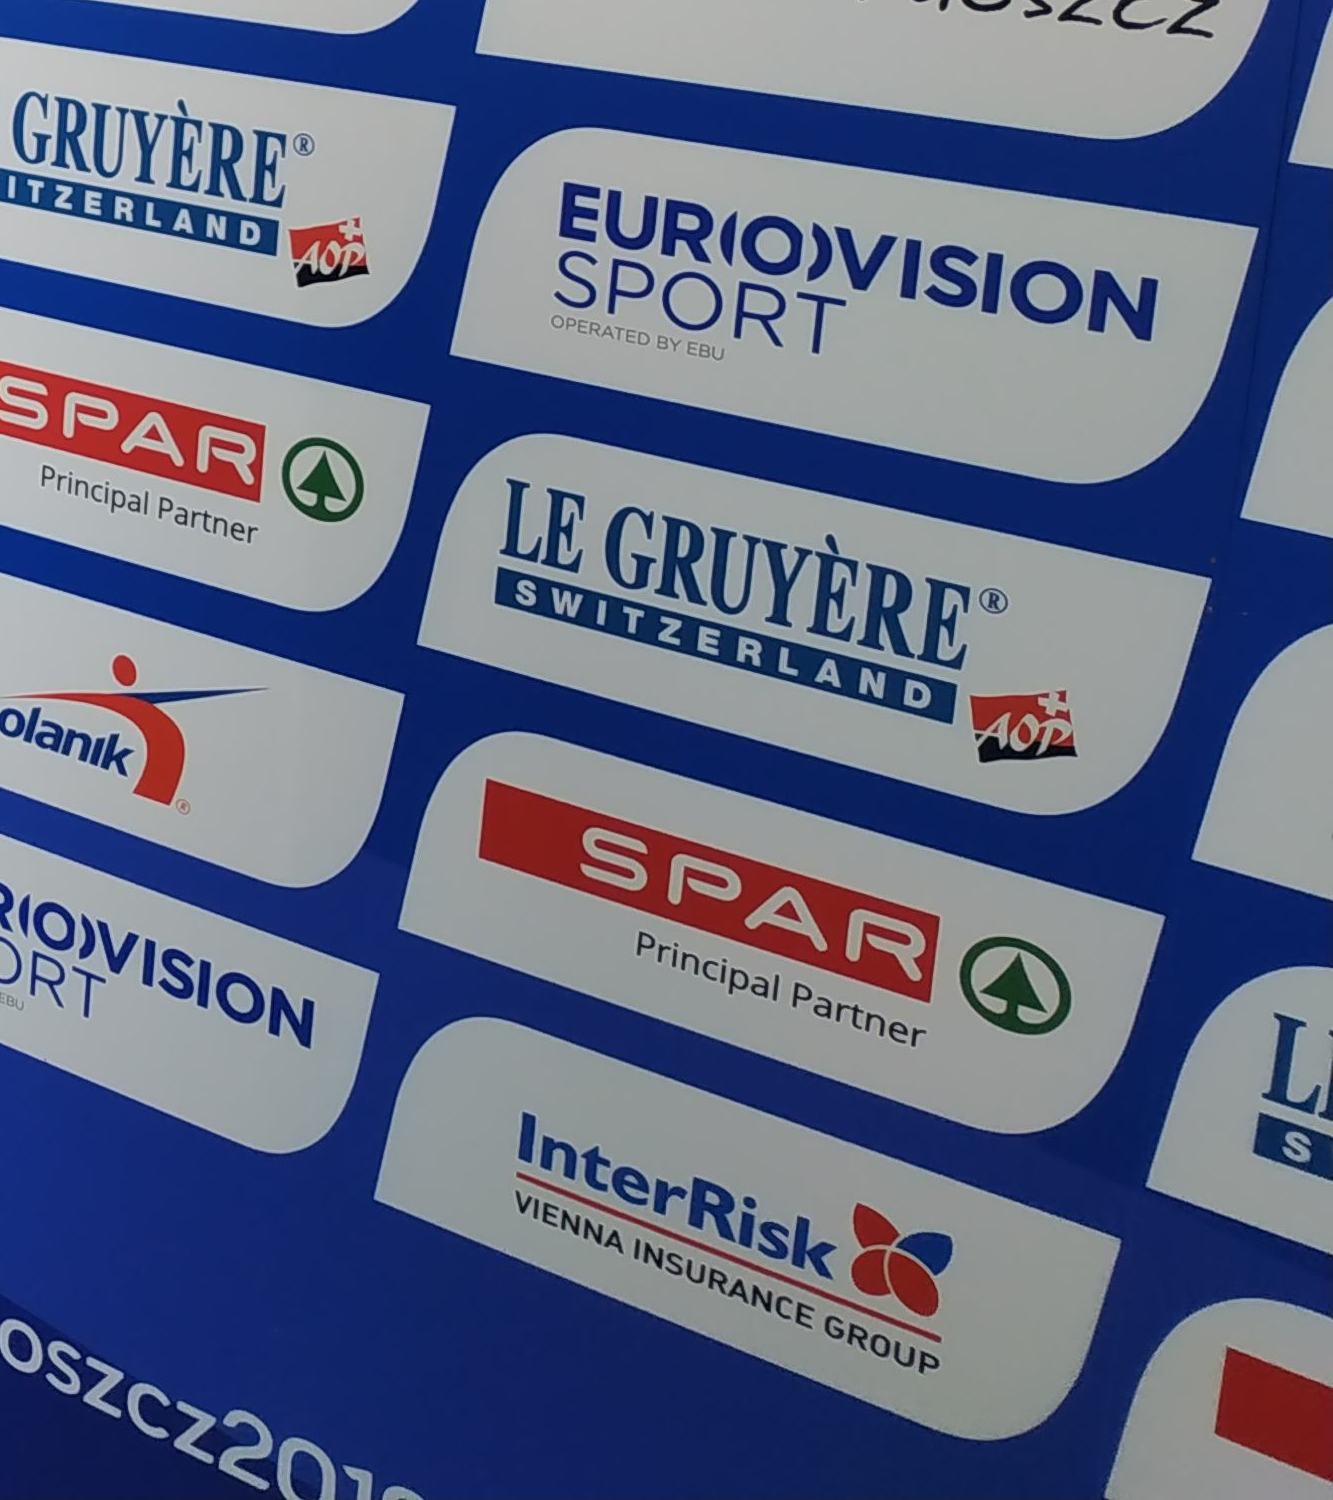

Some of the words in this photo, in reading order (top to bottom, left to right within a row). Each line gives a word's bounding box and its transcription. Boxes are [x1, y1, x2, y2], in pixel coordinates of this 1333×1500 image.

[550, 313, 651, 347] OPERATED
[656, 332, 682, 353] BY
[687, 338, 725, 363] EBU
[553, 251, 847, 355] SPORT
[40, 465, 149, 517] Principal
[158, 497, 259, 545] Partner
[500, 479, 585, 574] LE
[514, 579, 934, 712] SWITZERLAND
[580, 826, 928, 983] SPAR
[636, 931, 781, 1004] Principal
[792, 982, 928, 1049] Partner
[517, 1111, 837, 1281] InterRisk
[514, 1191, 626, 1255] VIENNA
[633, 1238, 814, 1330] INSURANCE
[825, 1314, 941, 1378] GROUP
